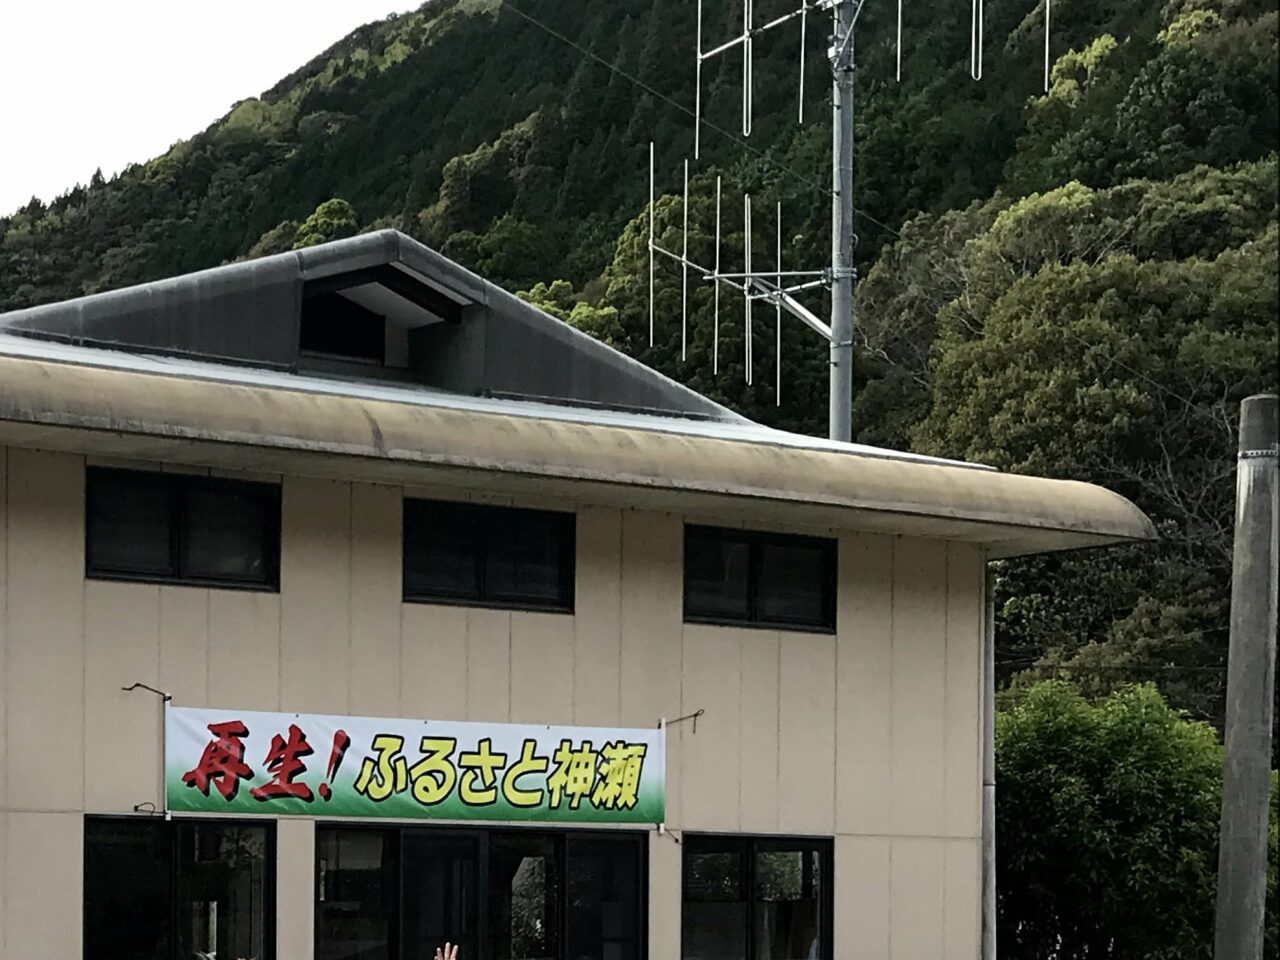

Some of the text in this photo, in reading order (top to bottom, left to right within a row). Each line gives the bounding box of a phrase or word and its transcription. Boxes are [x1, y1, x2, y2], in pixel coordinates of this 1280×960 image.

[181, 718, 648, 811] 再生! ふるさと神瀬
